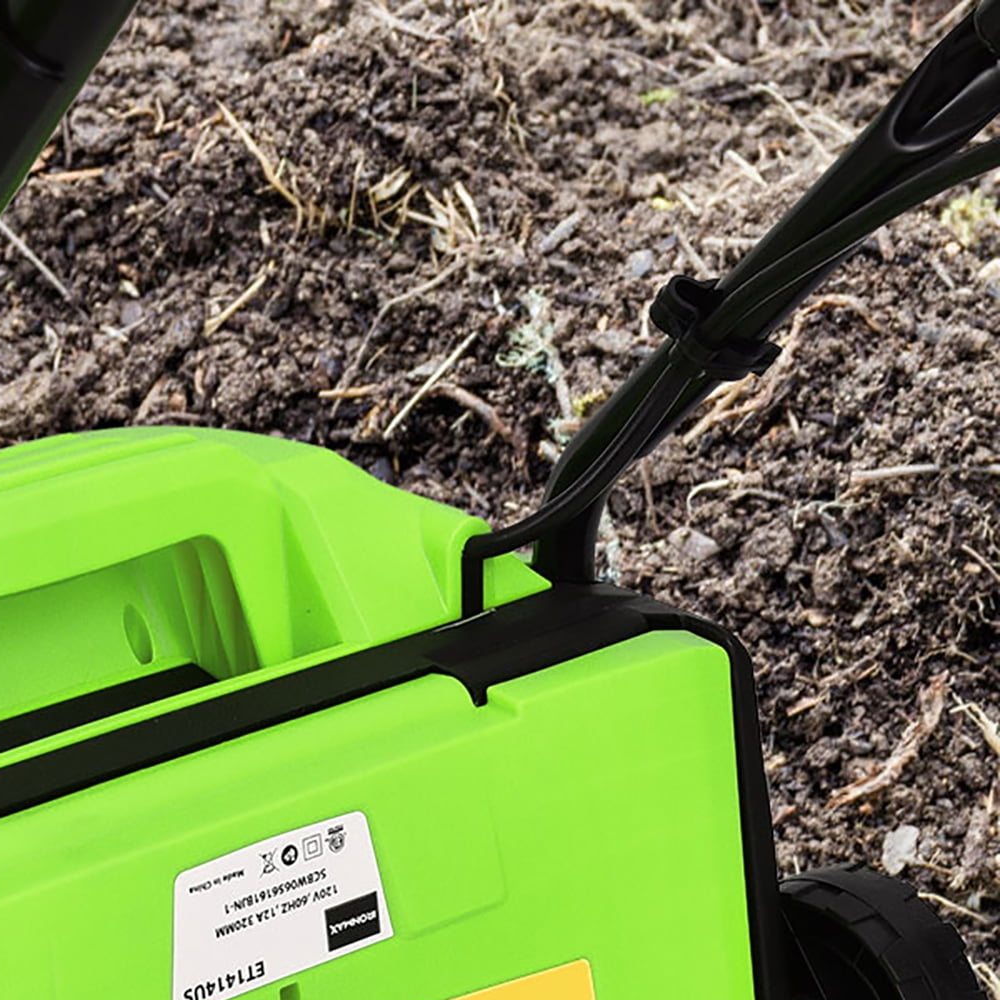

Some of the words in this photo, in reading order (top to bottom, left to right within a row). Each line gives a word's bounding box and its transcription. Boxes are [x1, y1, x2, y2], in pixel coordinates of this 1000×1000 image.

[223, 869, 245, 881] Made
[189, 880, 212, 894] China
[215, 915, 253, 938] 320MM
